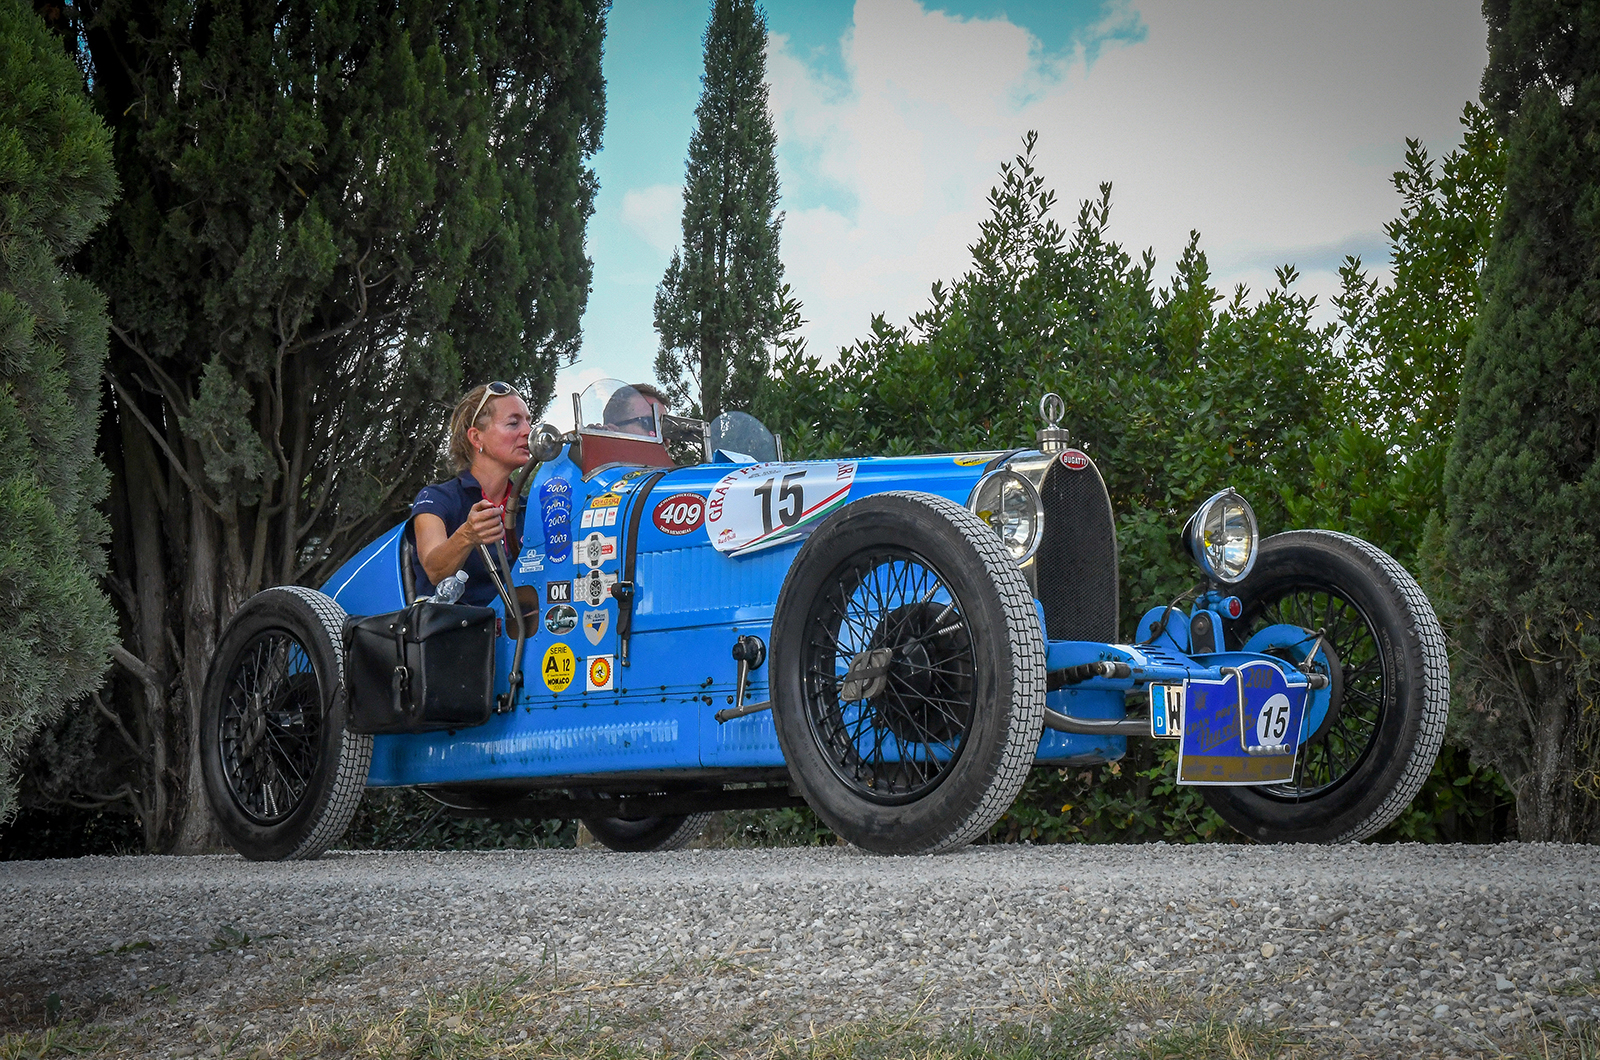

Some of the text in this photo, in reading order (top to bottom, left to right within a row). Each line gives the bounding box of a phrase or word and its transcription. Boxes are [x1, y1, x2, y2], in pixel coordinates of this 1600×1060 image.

[1063, 455, 1087, 466] BUGATTI
[546, 484, 567, 493] 2000
[709, 475, 738, 522] GRAN
[754, 470, 807, 534] 15
[548, 514, 567, 527] 2002
[660, 503, 702, 525] 409
[549, 534, 567, 544] 2003
[718, 532, 737, 544] Red Bull
[551, 584, 567, 600] OK
[550, 646, 567, 655] SERIE
[545, 656, 570, 674] A 12
[547, 677, 570, 686] MONACO
[1245, 668, 1273, 689] 2018
[1166, 691, 1181, 731] W
[1157, 716, 1164, 728] D
[1262, 706, 1289, 739] 15
